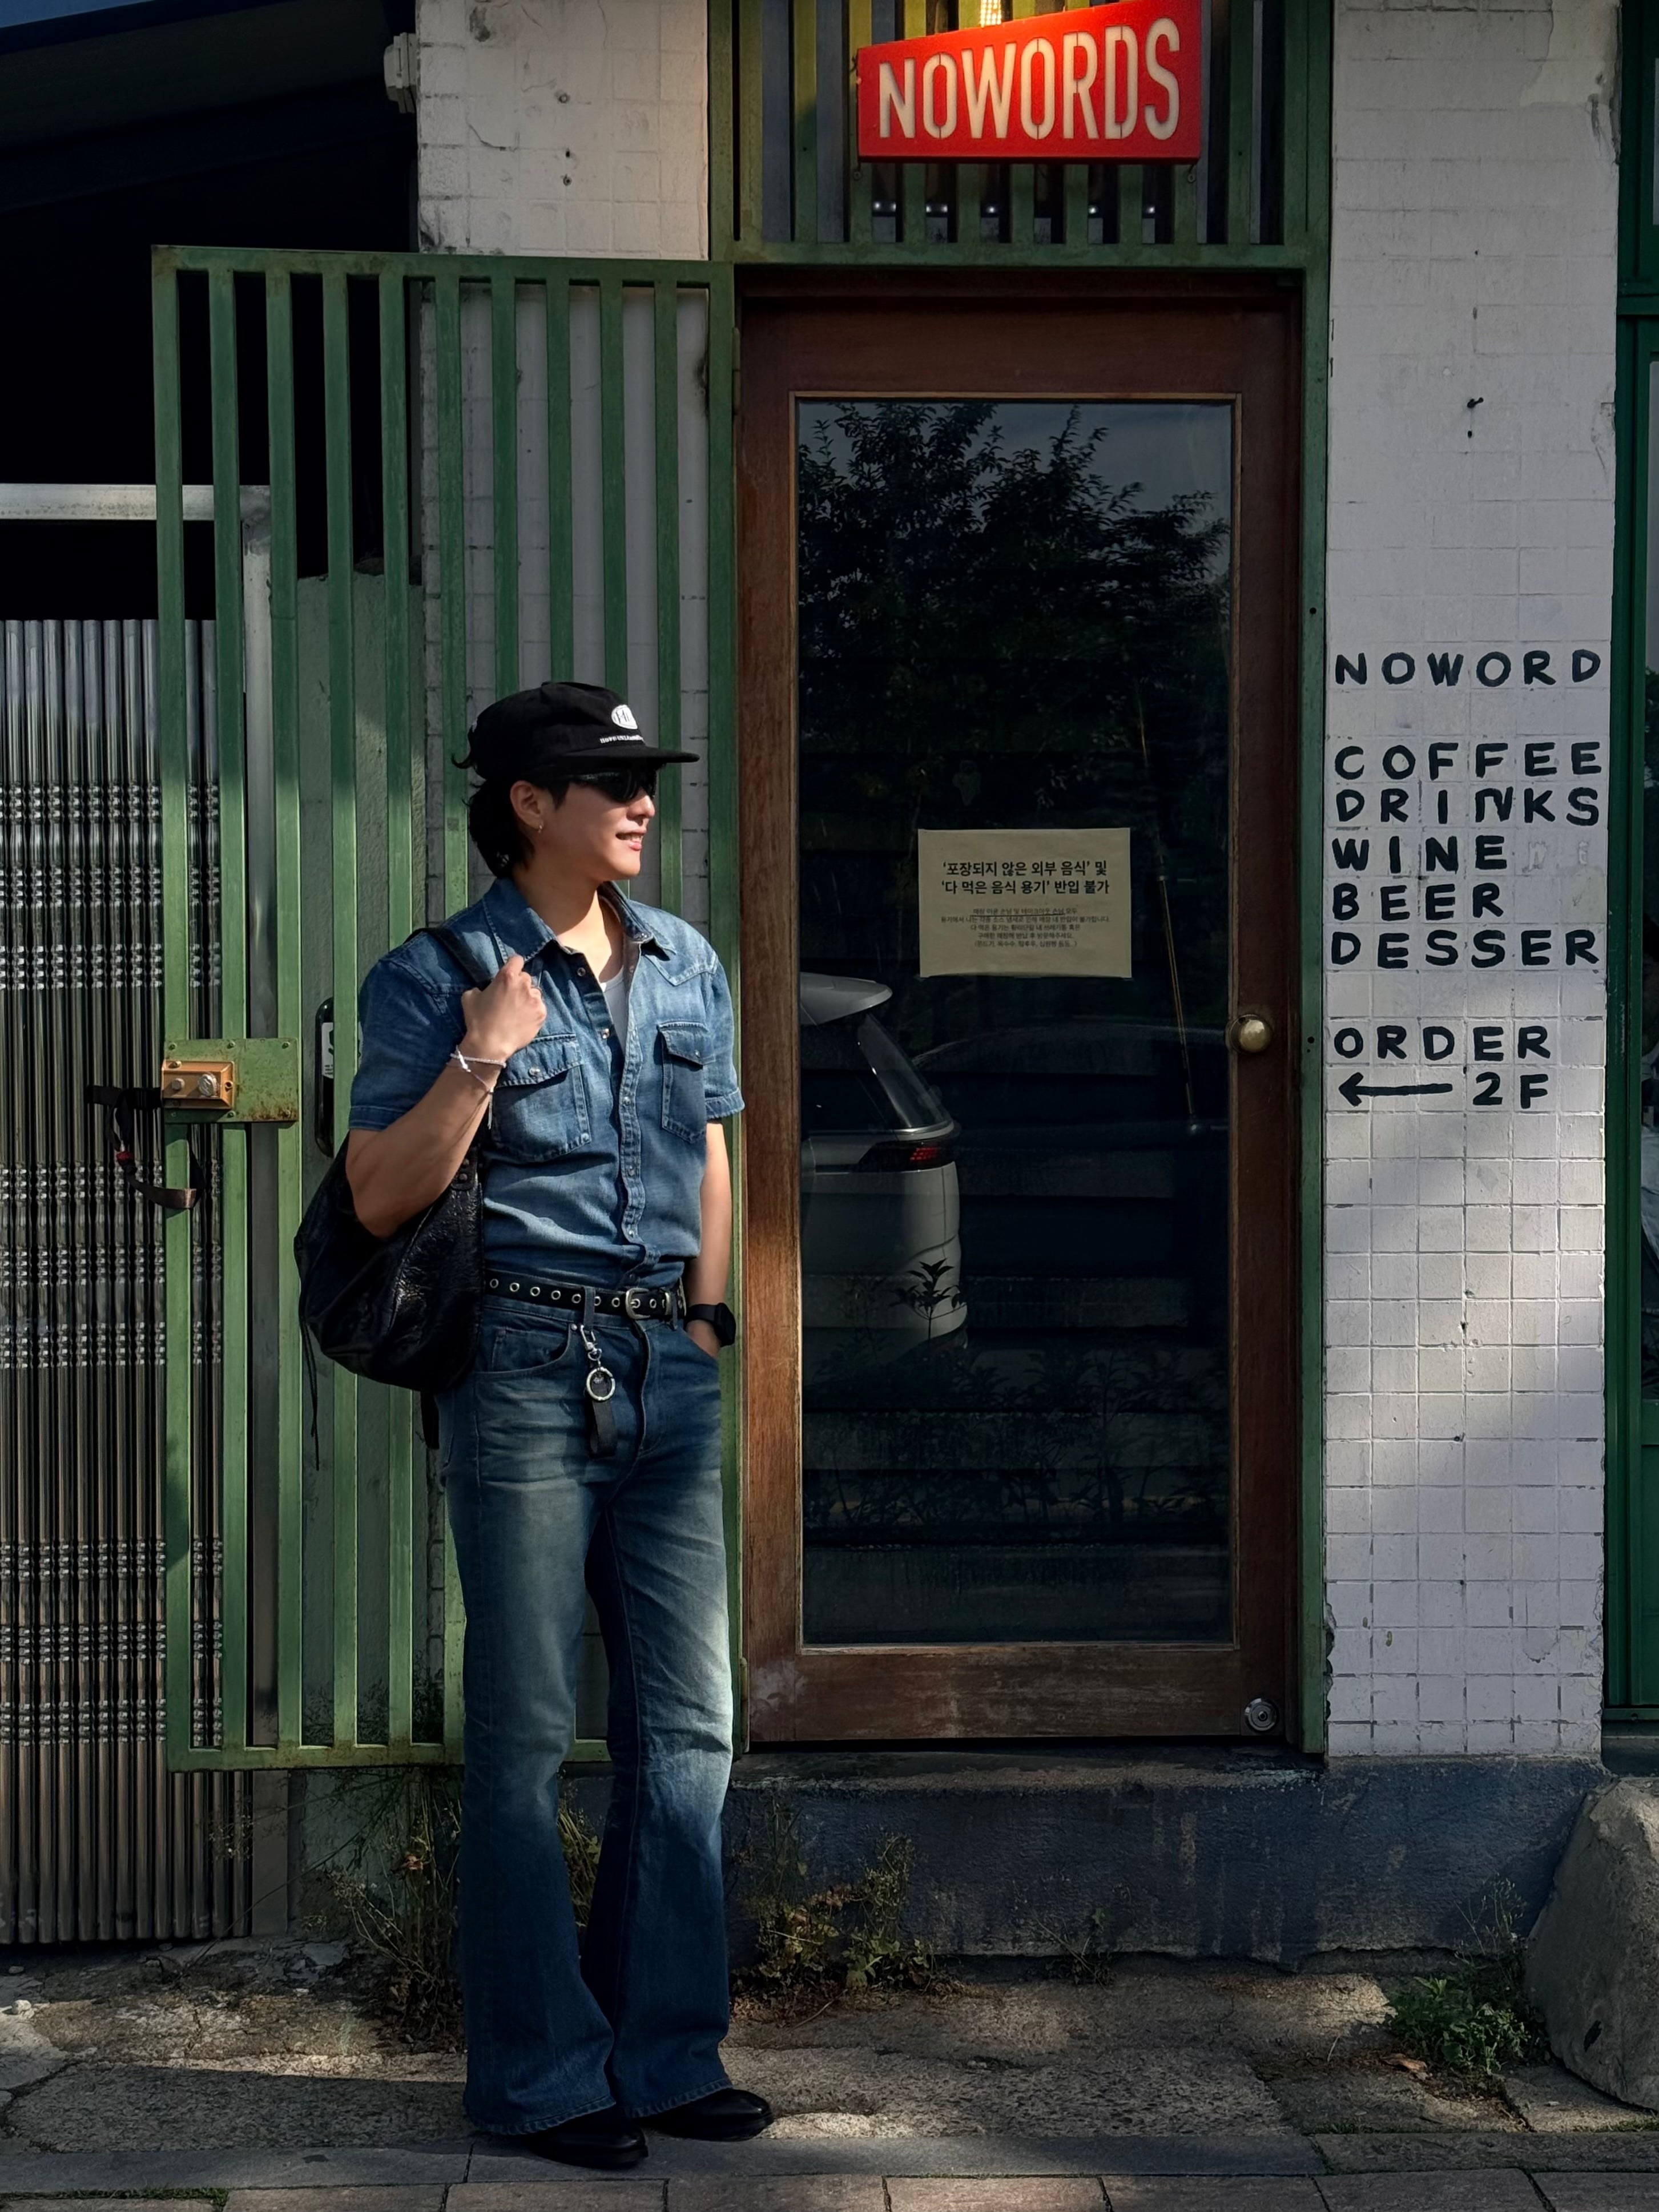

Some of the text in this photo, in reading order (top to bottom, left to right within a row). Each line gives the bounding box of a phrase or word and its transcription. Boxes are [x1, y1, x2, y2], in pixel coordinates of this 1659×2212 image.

[879, 17, 1181, 140] NOWORDS
[1335, 650, 1601, 688] NOWORD
[1335, 742, 1602, 781] COFFEE
[1336, 787, 1600, 827] DRINKS
[1001, 860, 1027, 877] 않은
[1031, 860, 1057, 877] 외부
[1094, 860, 1107, 877] 및
[1332, 836, 1508, 875] WINE
[961, 880, 987, 895] 먹은
[991, 880, 1016, 895] 음식
[1054, 880, 1079, 895] 반입
[1084, 880, 1110, 895] 불가
[1332, 883, 1504, 922] BEER
[1331, 929, 1599, 970] DESSER
[1334, 1025, 1552, 1062] ORDER
[1473, 1071, 1549, 1110] 2F
